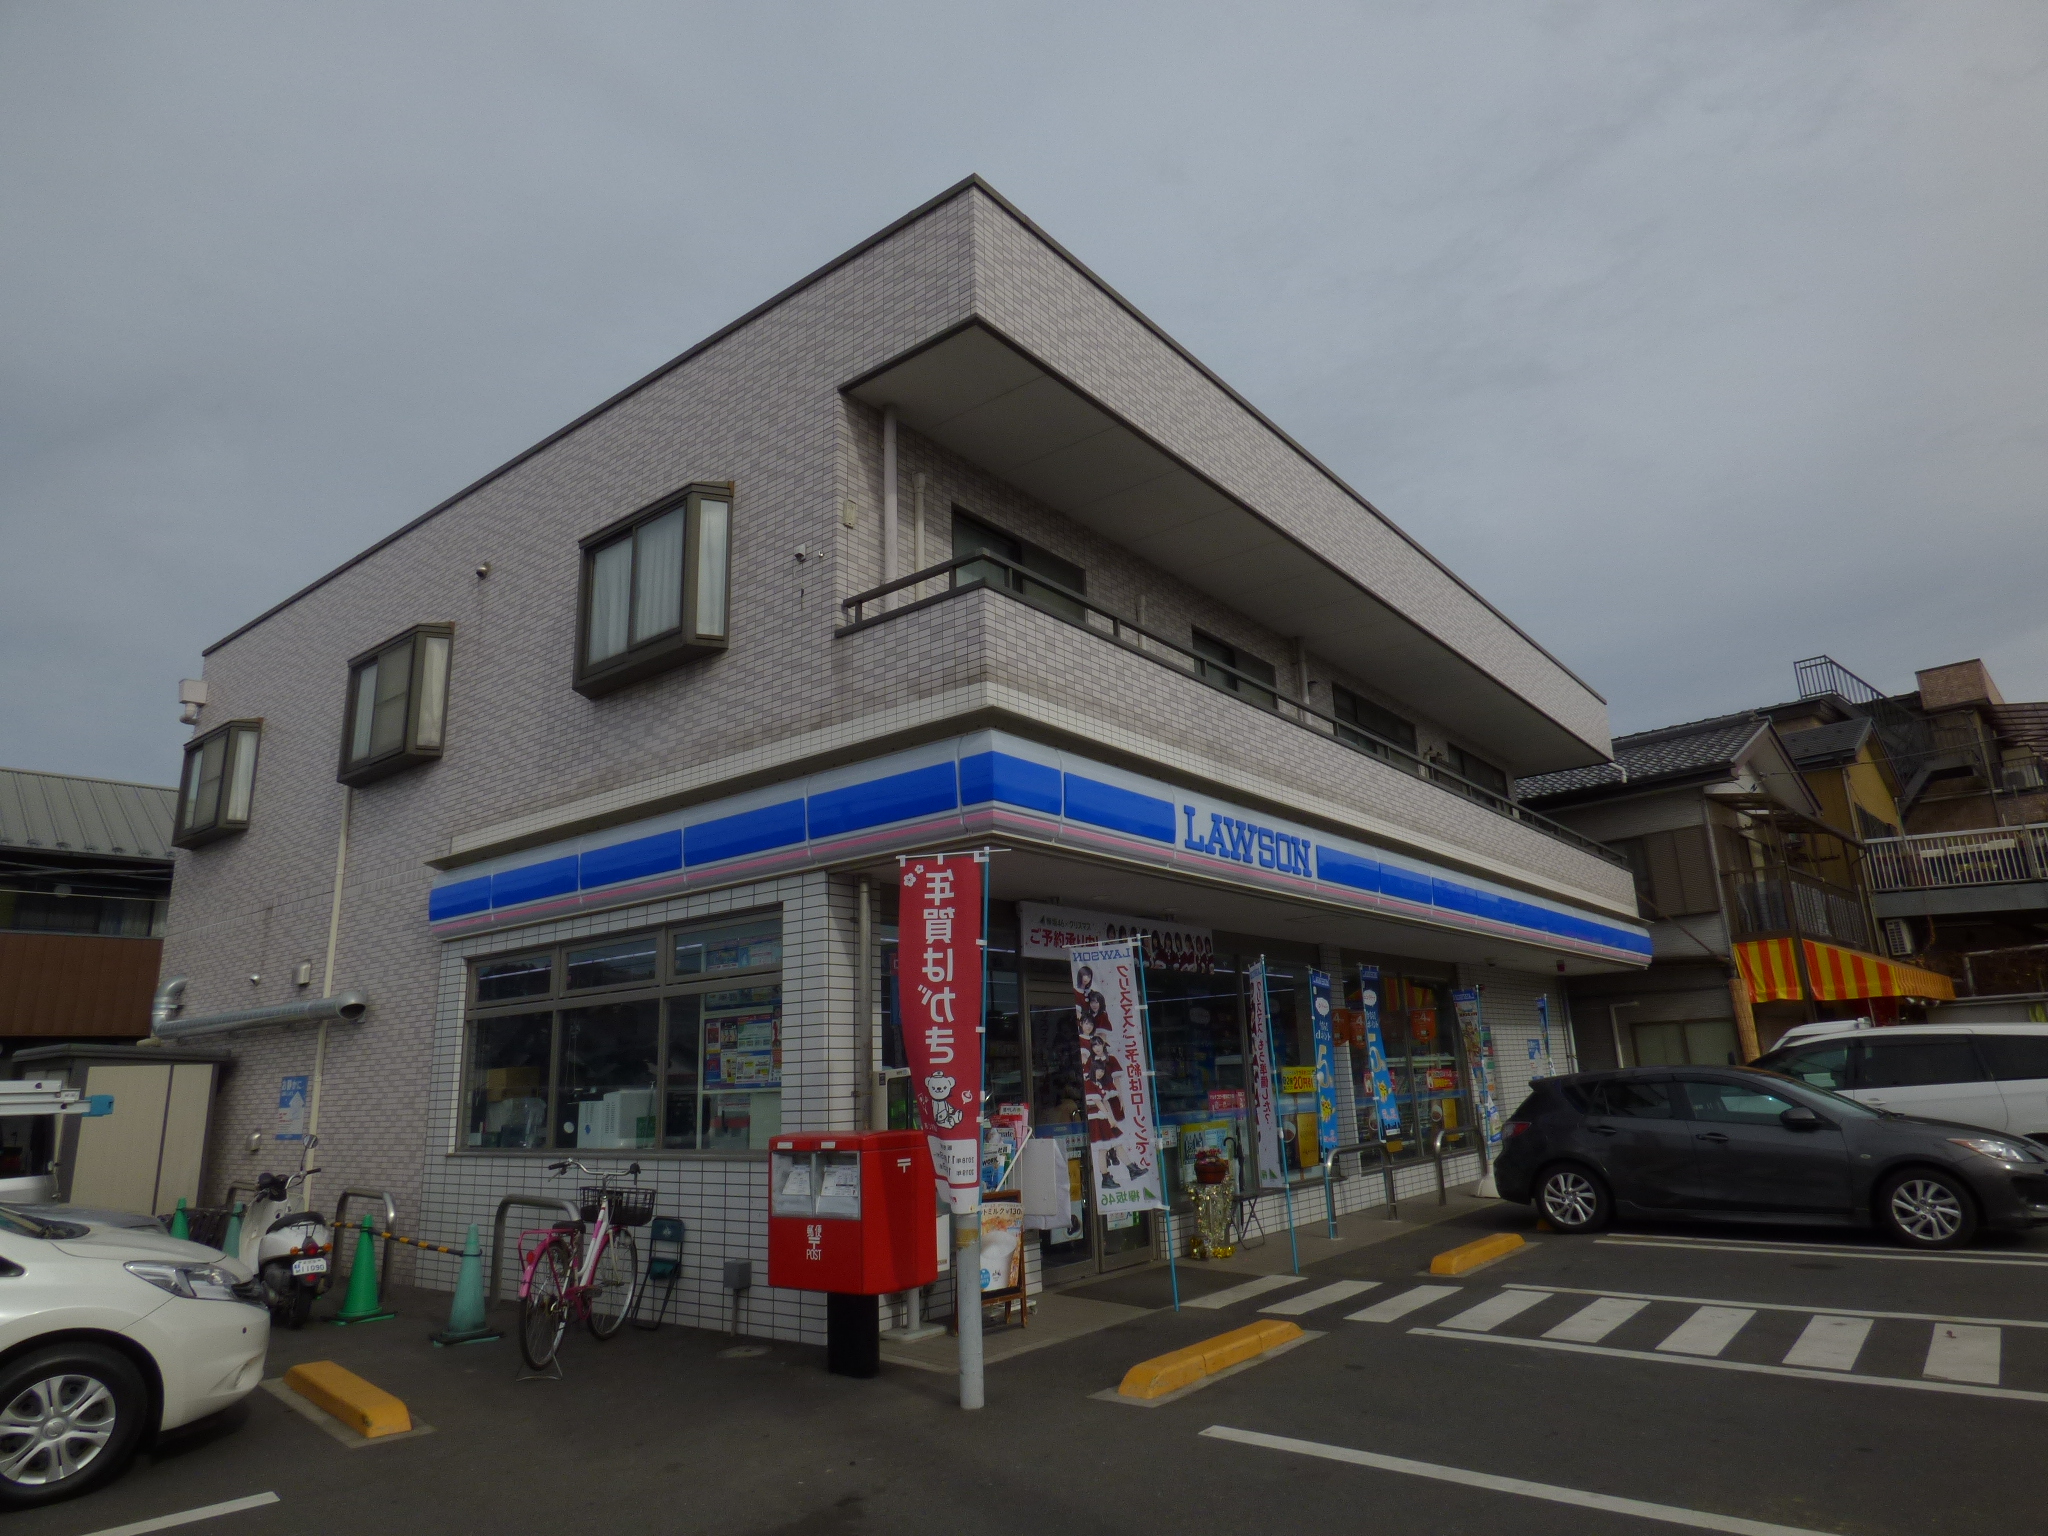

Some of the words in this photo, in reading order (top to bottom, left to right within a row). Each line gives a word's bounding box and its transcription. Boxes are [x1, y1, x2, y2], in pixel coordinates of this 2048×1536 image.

[1183, 804, 1312, 877] LAWSON
[807, 1224, 822, 1238] 郵便
[807, 1249, 822, 1260] POST
